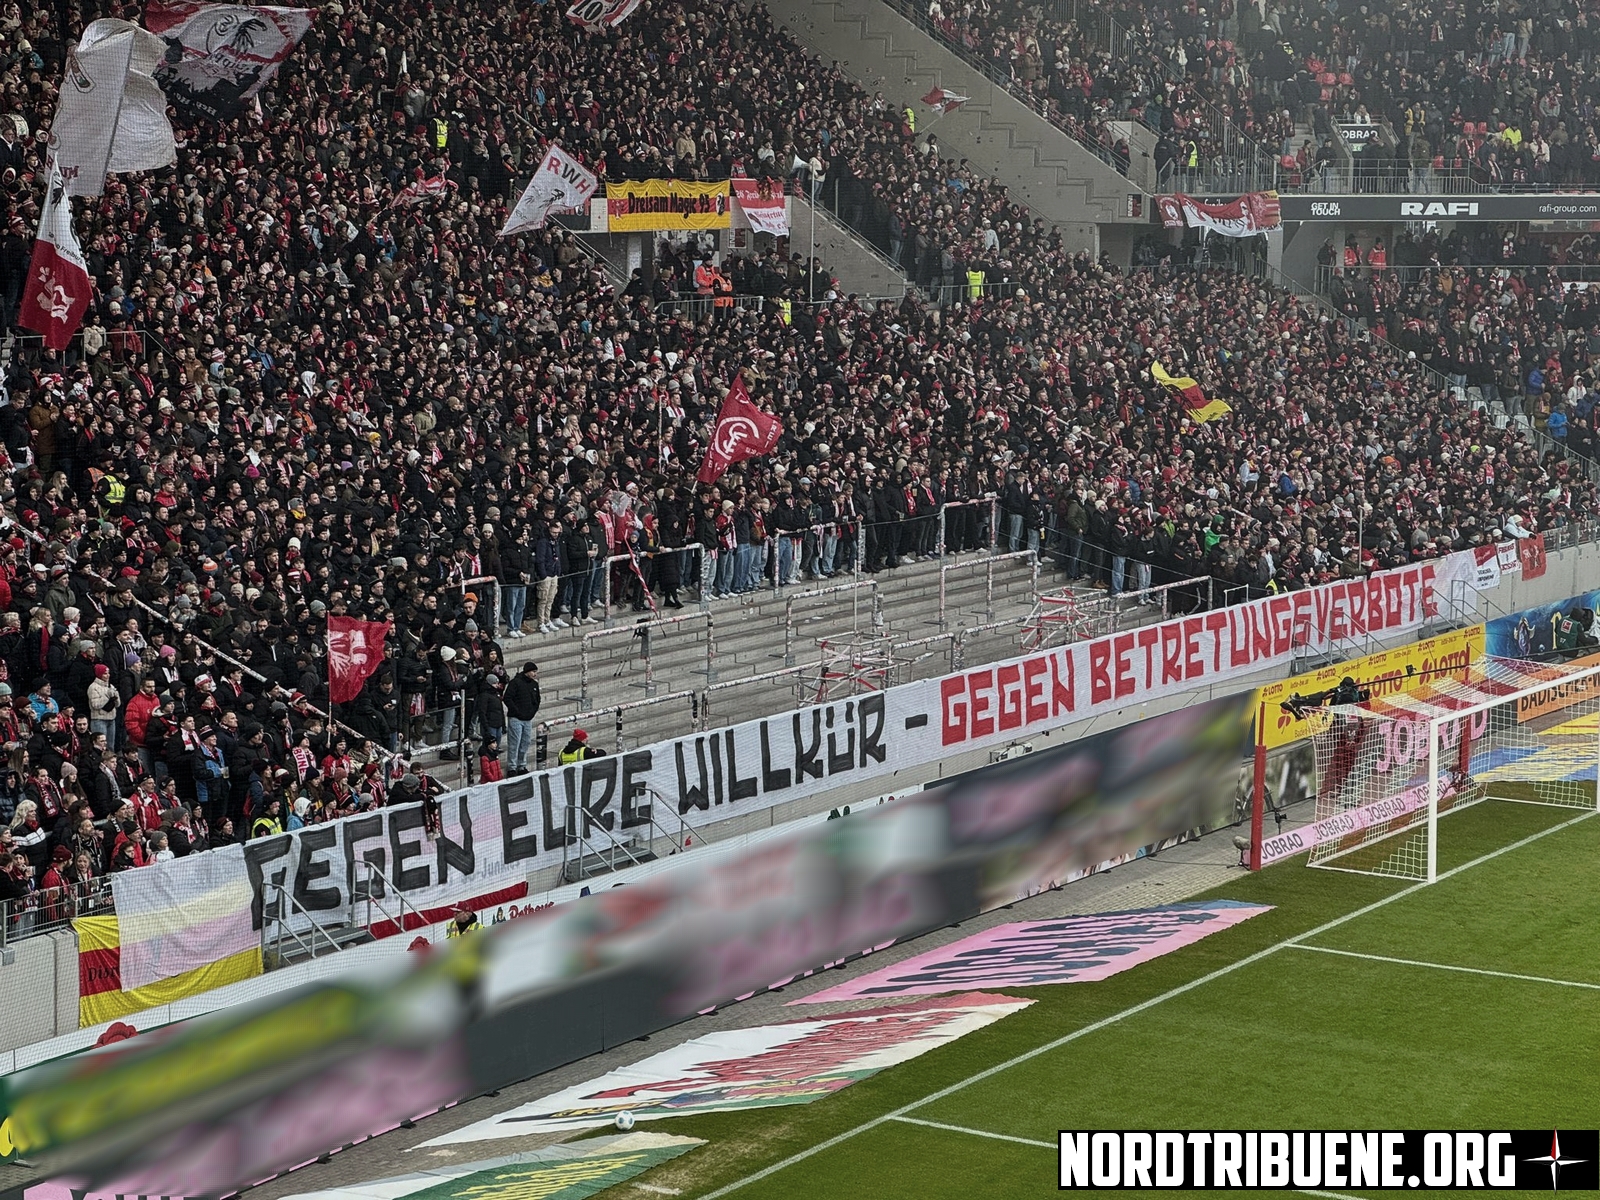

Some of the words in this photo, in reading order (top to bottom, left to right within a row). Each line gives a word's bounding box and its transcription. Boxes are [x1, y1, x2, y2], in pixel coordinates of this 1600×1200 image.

[546, 155, 591, 195] RWH
[627, 191, 668, 214] Dreisam
[669, 191, 697, 219] Magic
[1311, 208, 1341, 216] TOUCH
[1400, 202, 1479, 216] RAFI
[1538, 203, 1597, 214] rafi-group.com
[1434, 650, 1466, 680] LOTTO
[1268, 683, 1283, 694] LOTTO
[244, 794, 475, 932] GEGEN
[498, 750, 652, 865] EURE
[674, 692, 886, 815] WILLKÜR
[940, 648, 1076, 746] GEGEN
[1089, 564, 1438, 705] BETRETUNGSVERBOTE
[1375, 706, 1488, 773] JOBD
[1412, 779, 1447, 804] JOBAD
[1367, 798, 1406, 823] JOBRAD
[1313, 814, 1355, 841] JOBRAD
[1262, 832, 1304, 860] JOBRAD
